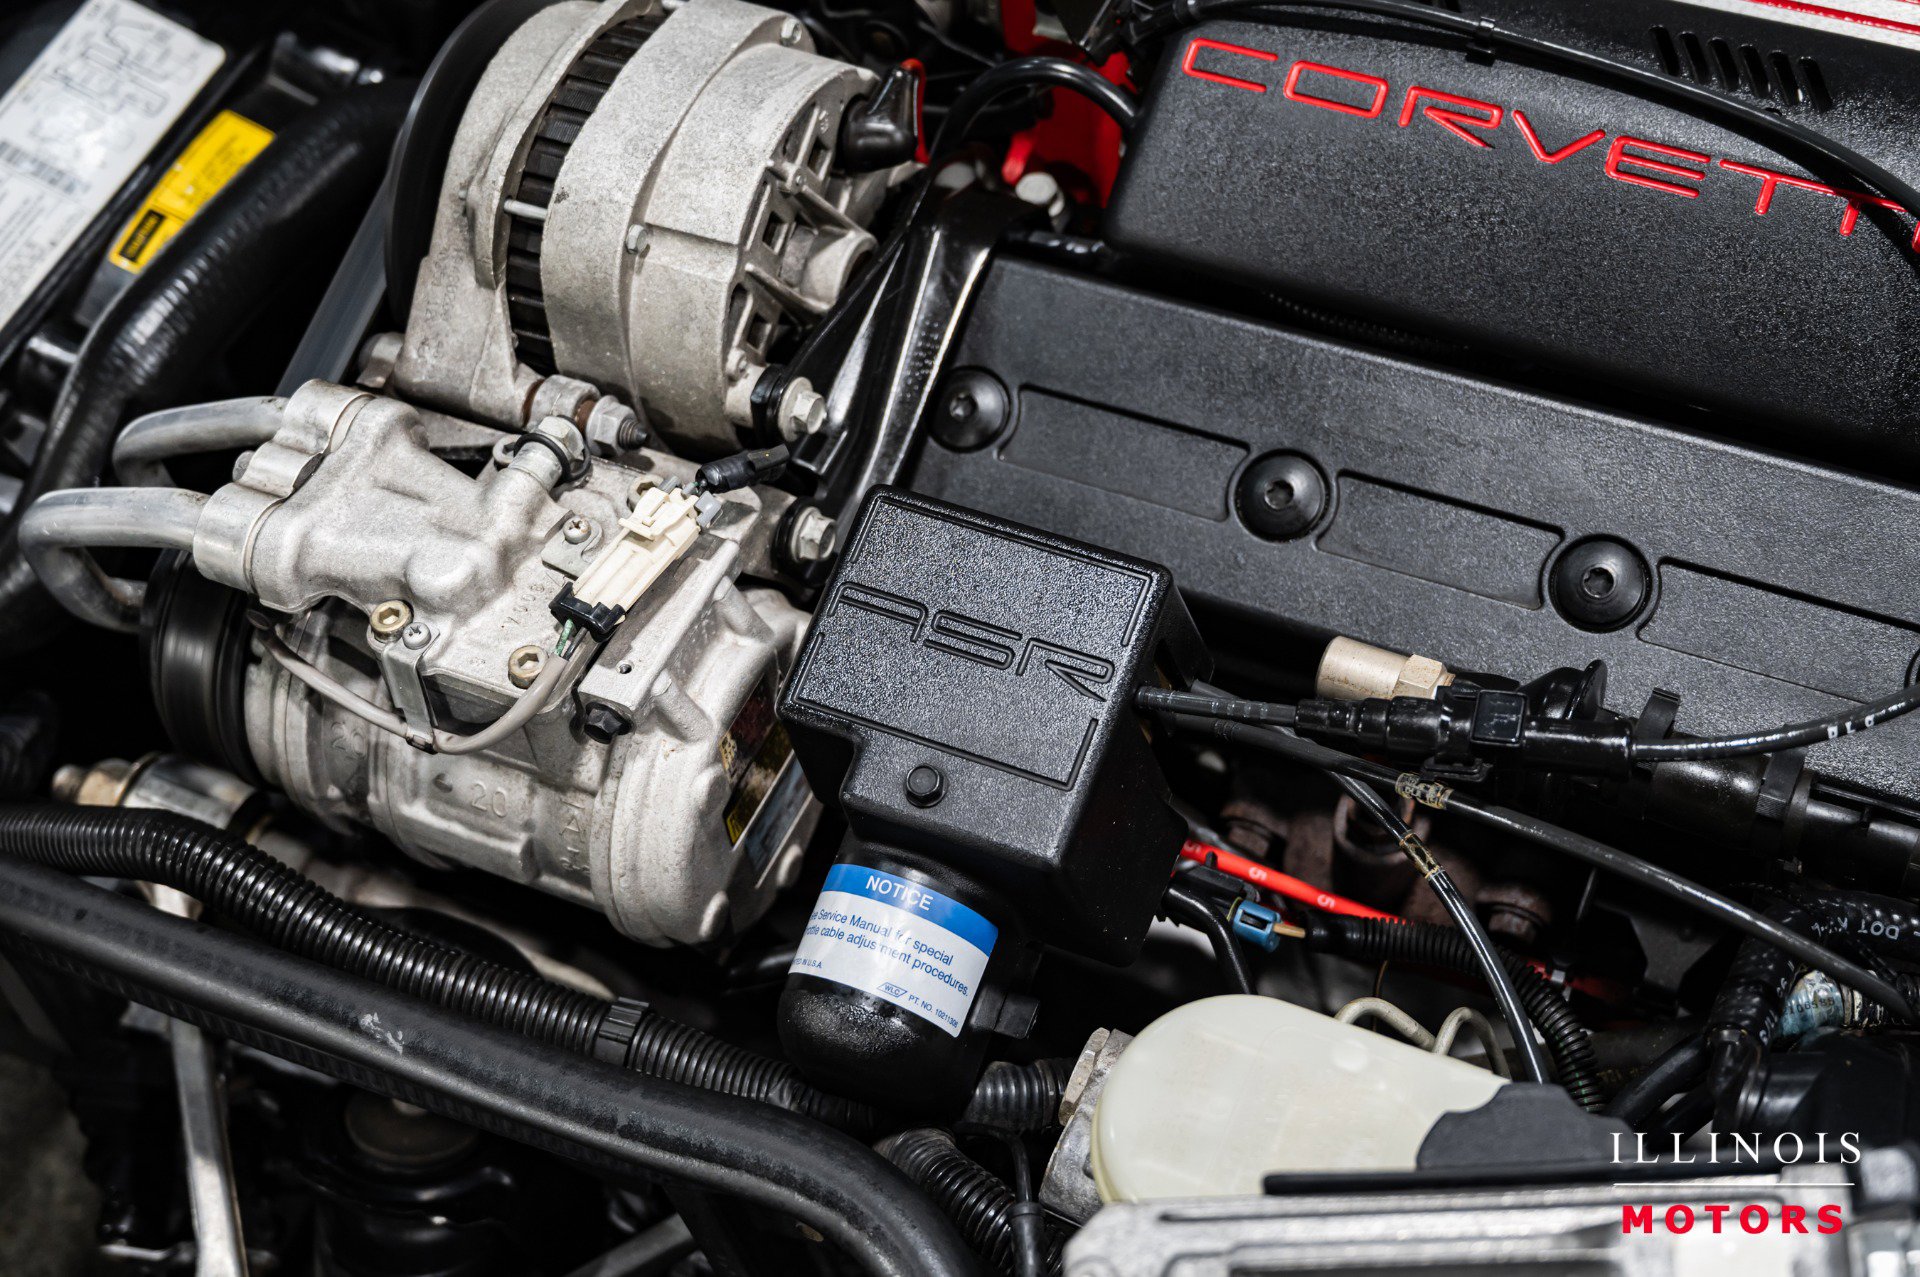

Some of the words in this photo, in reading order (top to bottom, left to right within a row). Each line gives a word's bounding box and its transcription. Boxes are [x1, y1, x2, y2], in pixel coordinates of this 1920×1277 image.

[1182, 37, 1920, 254] CORVETT
[827, 581, 1115, 702] ASR
[470, 780, 508, 819] 20
[865, 874, 934, 912] NOTICE
[1248, 866, 1269, 882] 5
[1316, 893, 1336, 910] 5
[818, 908, 848, 924] Service
[849, 914, 893, 939] Manual
[912, 940, 954, 967] special
[1857, 919, 1900, 940] DOT
[820, 926, 845, 940] cable
[846, 933, 912, 964] adjusment
[911, 958, 969, 997] procedures.
[884, 984, 901, 996] WLC
[908, 994, 919, 1006] PT.
[920, 1000, 933, 1013] NO.
